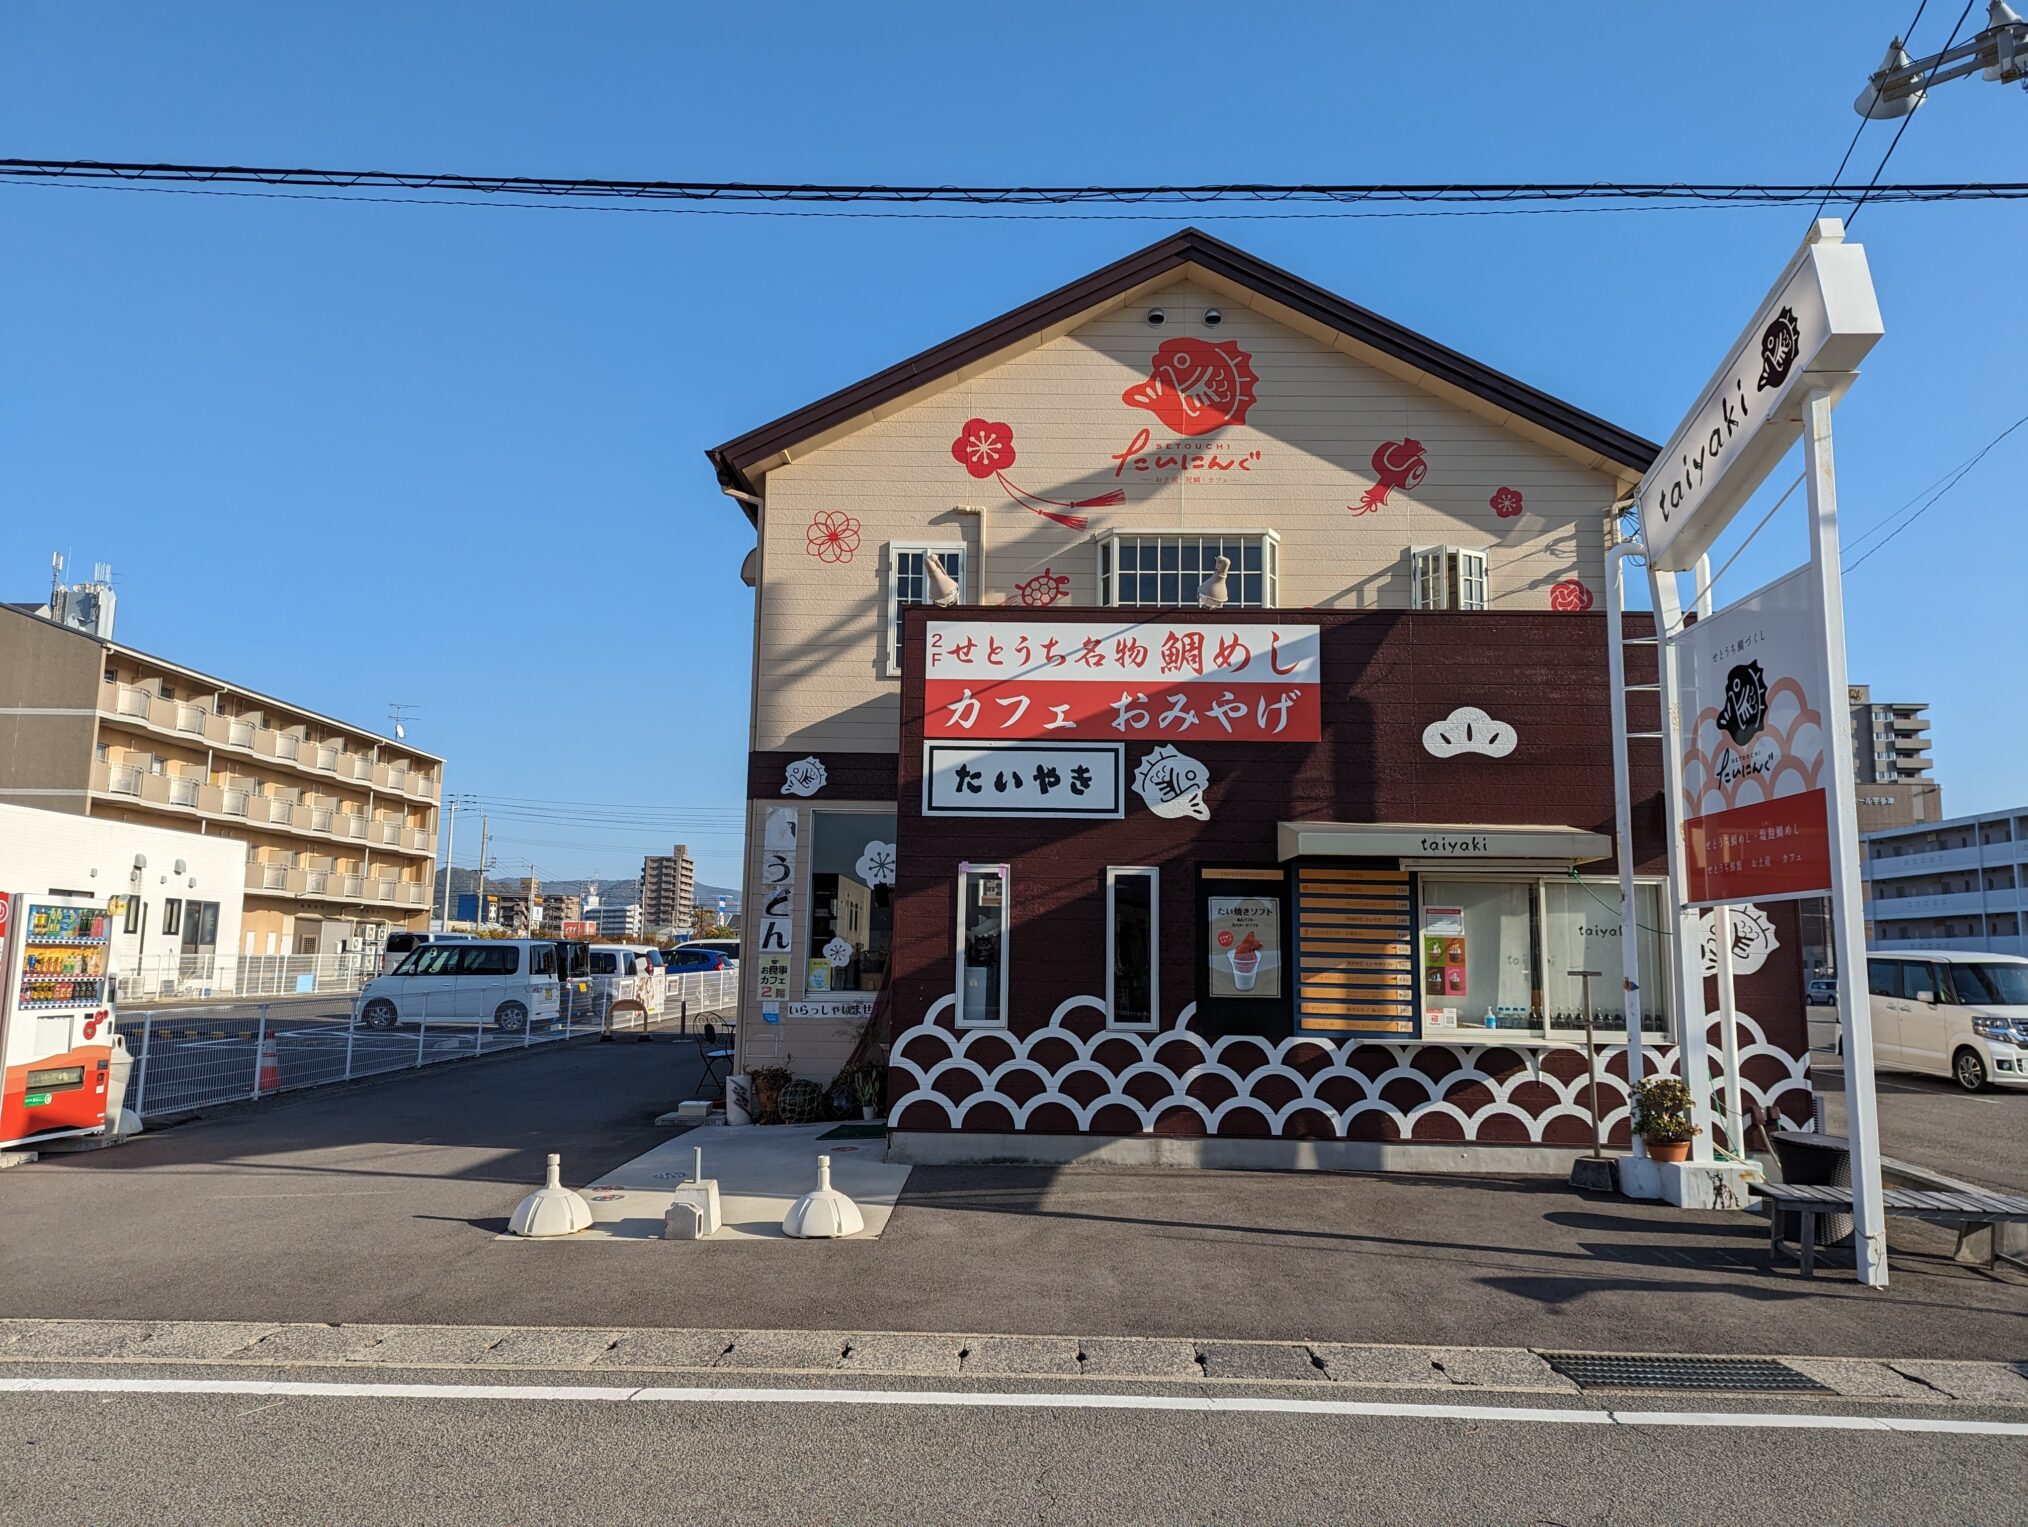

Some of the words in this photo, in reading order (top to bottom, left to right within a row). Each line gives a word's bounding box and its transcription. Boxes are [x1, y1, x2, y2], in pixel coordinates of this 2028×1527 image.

[1112, 428, 1261, 477] たいにんぐ
[1659, 378, 1748, 522] taiyaki
[944, 688, 1077, 729] カフェ
[1109, 689, 1302, 734] おみやげ
[954, 763, 1093, 796] たいやき
[1716, 747, 1774, 790] たいにんぐ
[1420, 836, 1488, 854] taiyaki
[1782, 853, 1802, 863] カフェ
[761, 854, 791, 950] うどん
[1217, 907, 1273, 917] たい焼きソフト
[760, 965, 788, 976] お食事
[760, 975, 786, 985] カフェ
